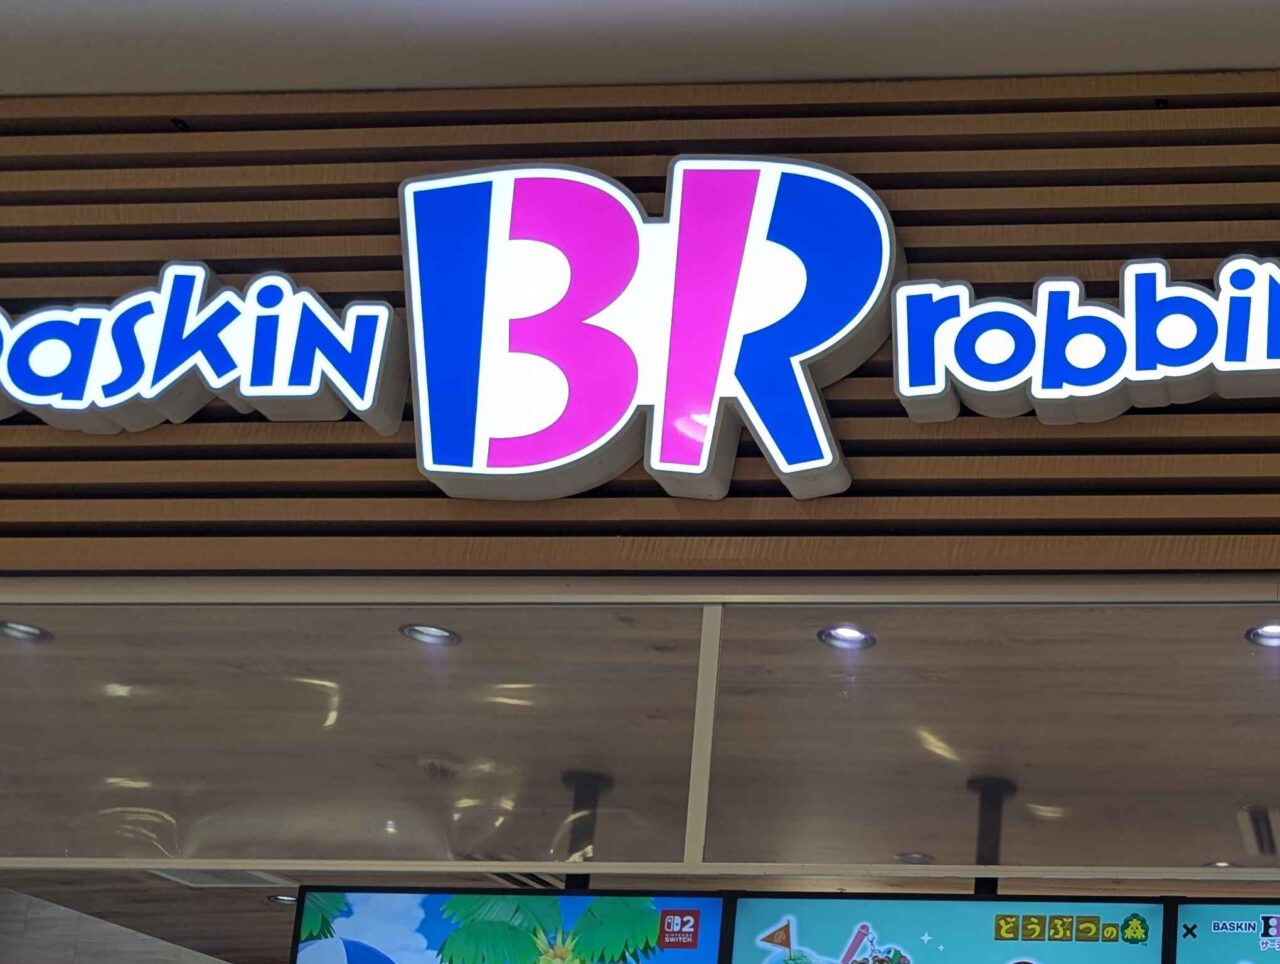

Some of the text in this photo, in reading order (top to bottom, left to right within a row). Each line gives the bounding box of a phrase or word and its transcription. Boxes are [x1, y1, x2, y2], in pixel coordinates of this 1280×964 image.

[412, 168, 887, 469] BR
[998, 916, 1147, 940] どうぶつの森
[1212, 921, 1257, 932] BASKIN
